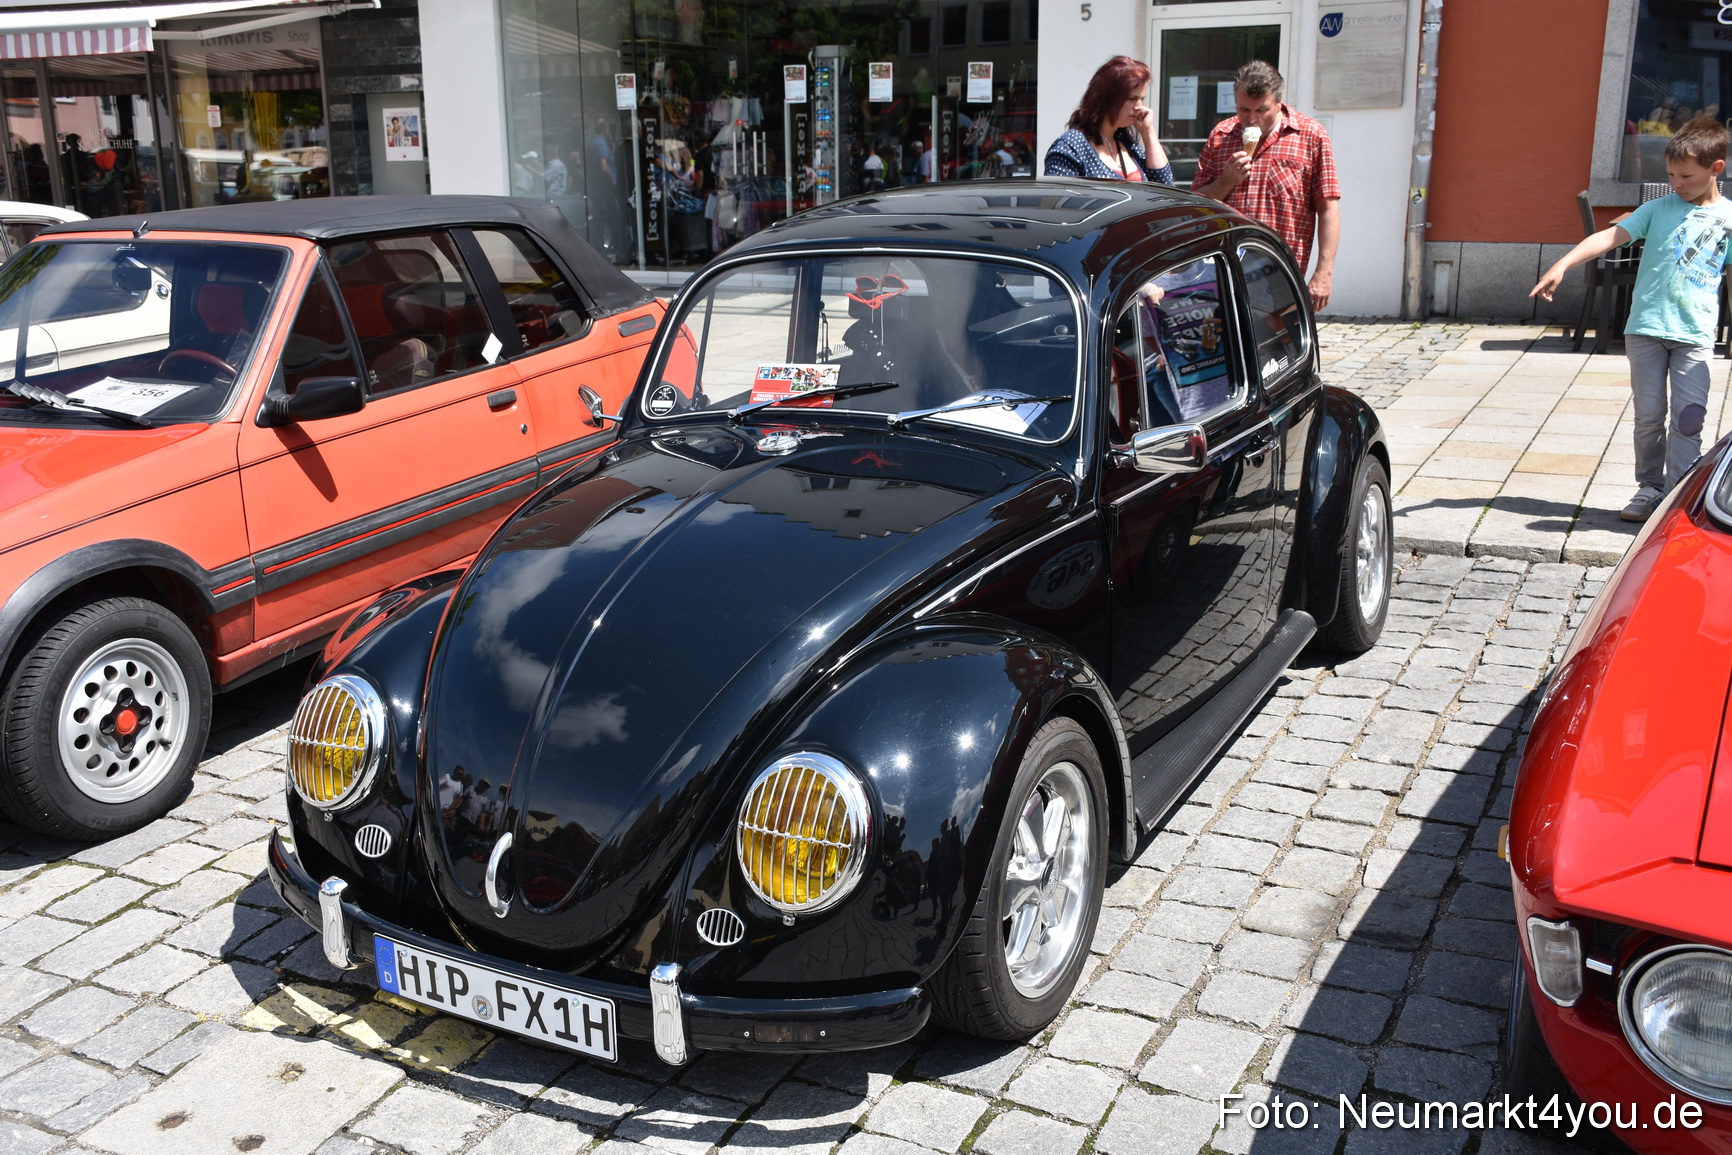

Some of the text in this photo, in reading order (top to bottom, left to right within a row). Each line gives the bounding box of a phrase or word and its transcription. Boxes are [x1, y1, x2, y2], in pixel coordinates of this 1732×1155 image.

[1081, 3, 1092, 21] 5
[1377, 12, 1404, 23] weber
[1320, 17, 1343, 32] AW
[287, 30, 310, 44] Shop
[131, 387, 169, 398] 356
[383, 970, 393, 984] D
[396, 950, 611, 1052] HIP FX1H
